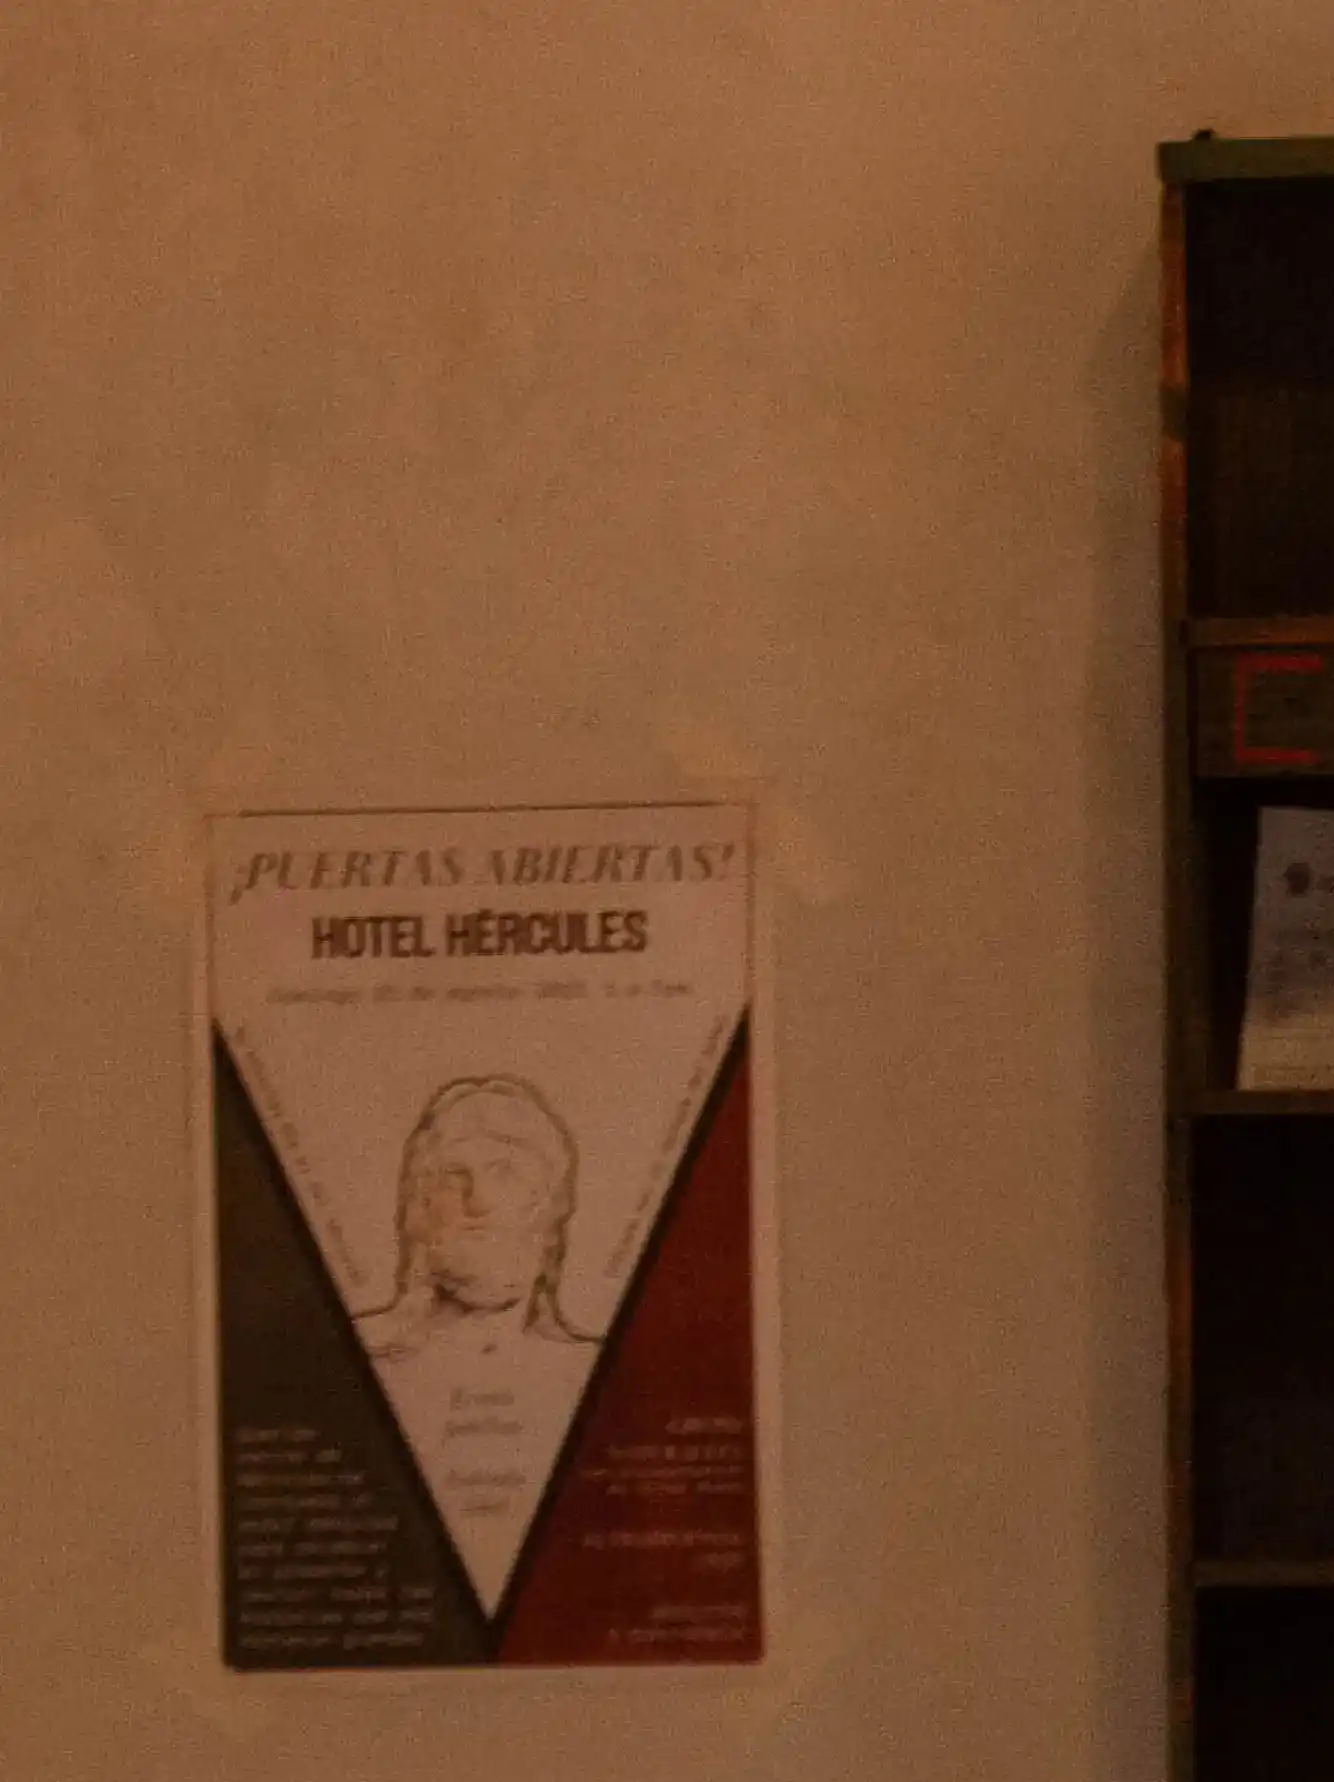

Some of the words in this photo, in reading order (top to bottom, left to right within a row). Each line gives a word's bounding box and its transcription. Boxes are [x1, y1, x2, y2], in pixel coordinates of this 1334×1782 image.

[480, 842, 735, 886] ABIERTAS!
[311, 915, 436, 959] HOTEL
[445, 908, 649, 956] HÉRCULES
